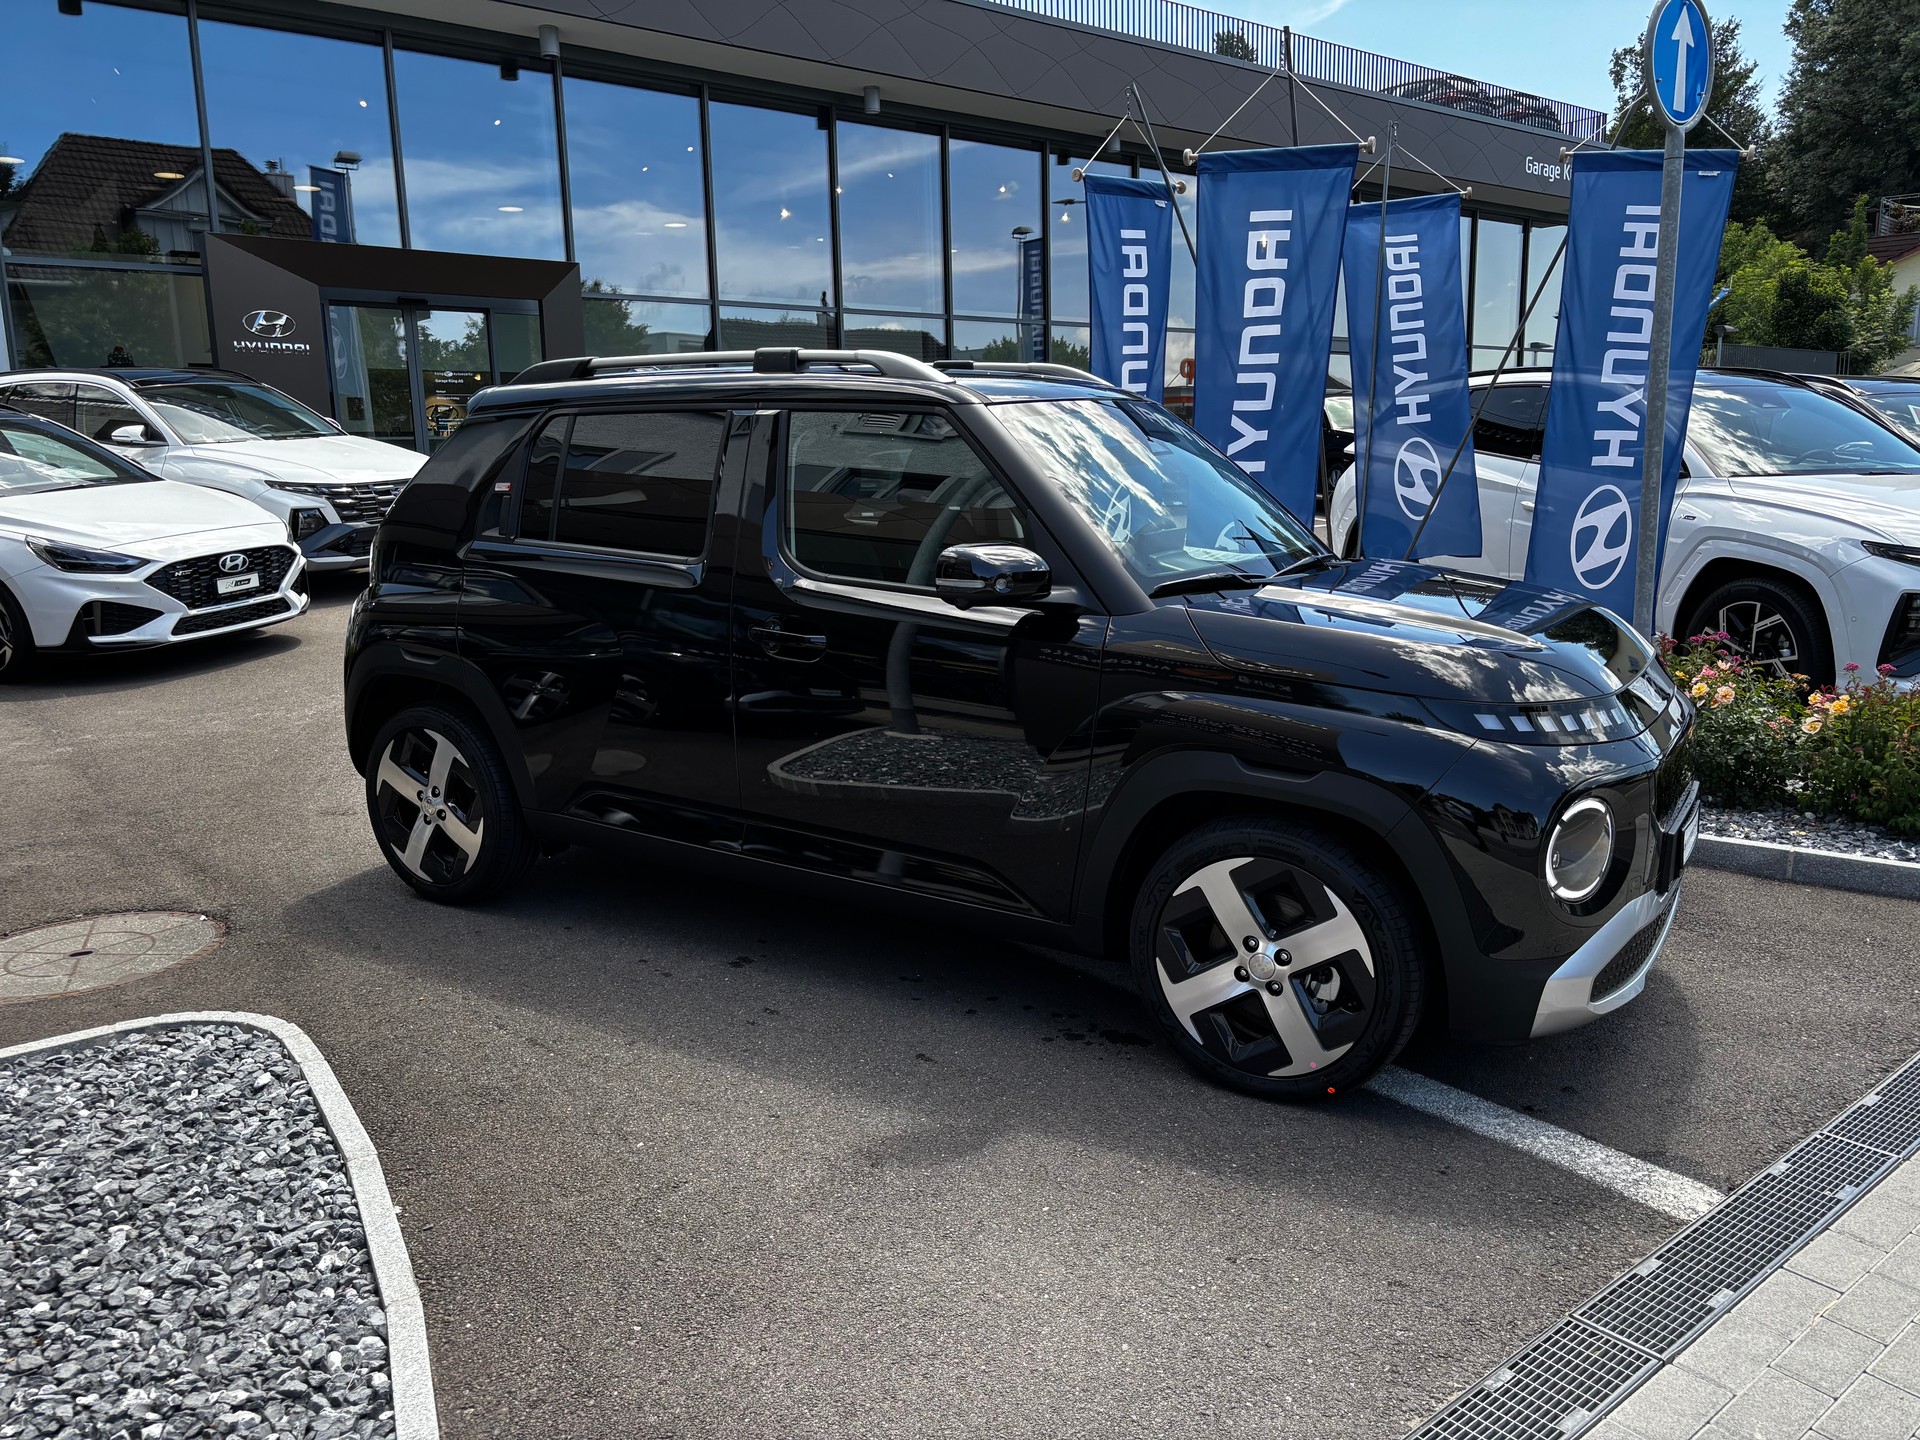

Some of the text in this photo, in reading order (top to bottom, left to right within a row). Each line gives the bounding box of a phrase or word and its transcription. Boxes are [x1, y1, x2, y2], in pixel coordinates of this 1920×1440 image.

[1525, 156, 1561, 182] Garage
[1385, 233, 1431, 425] HYUNDAI
[233, 340, 310, 355] HYUNDAI
